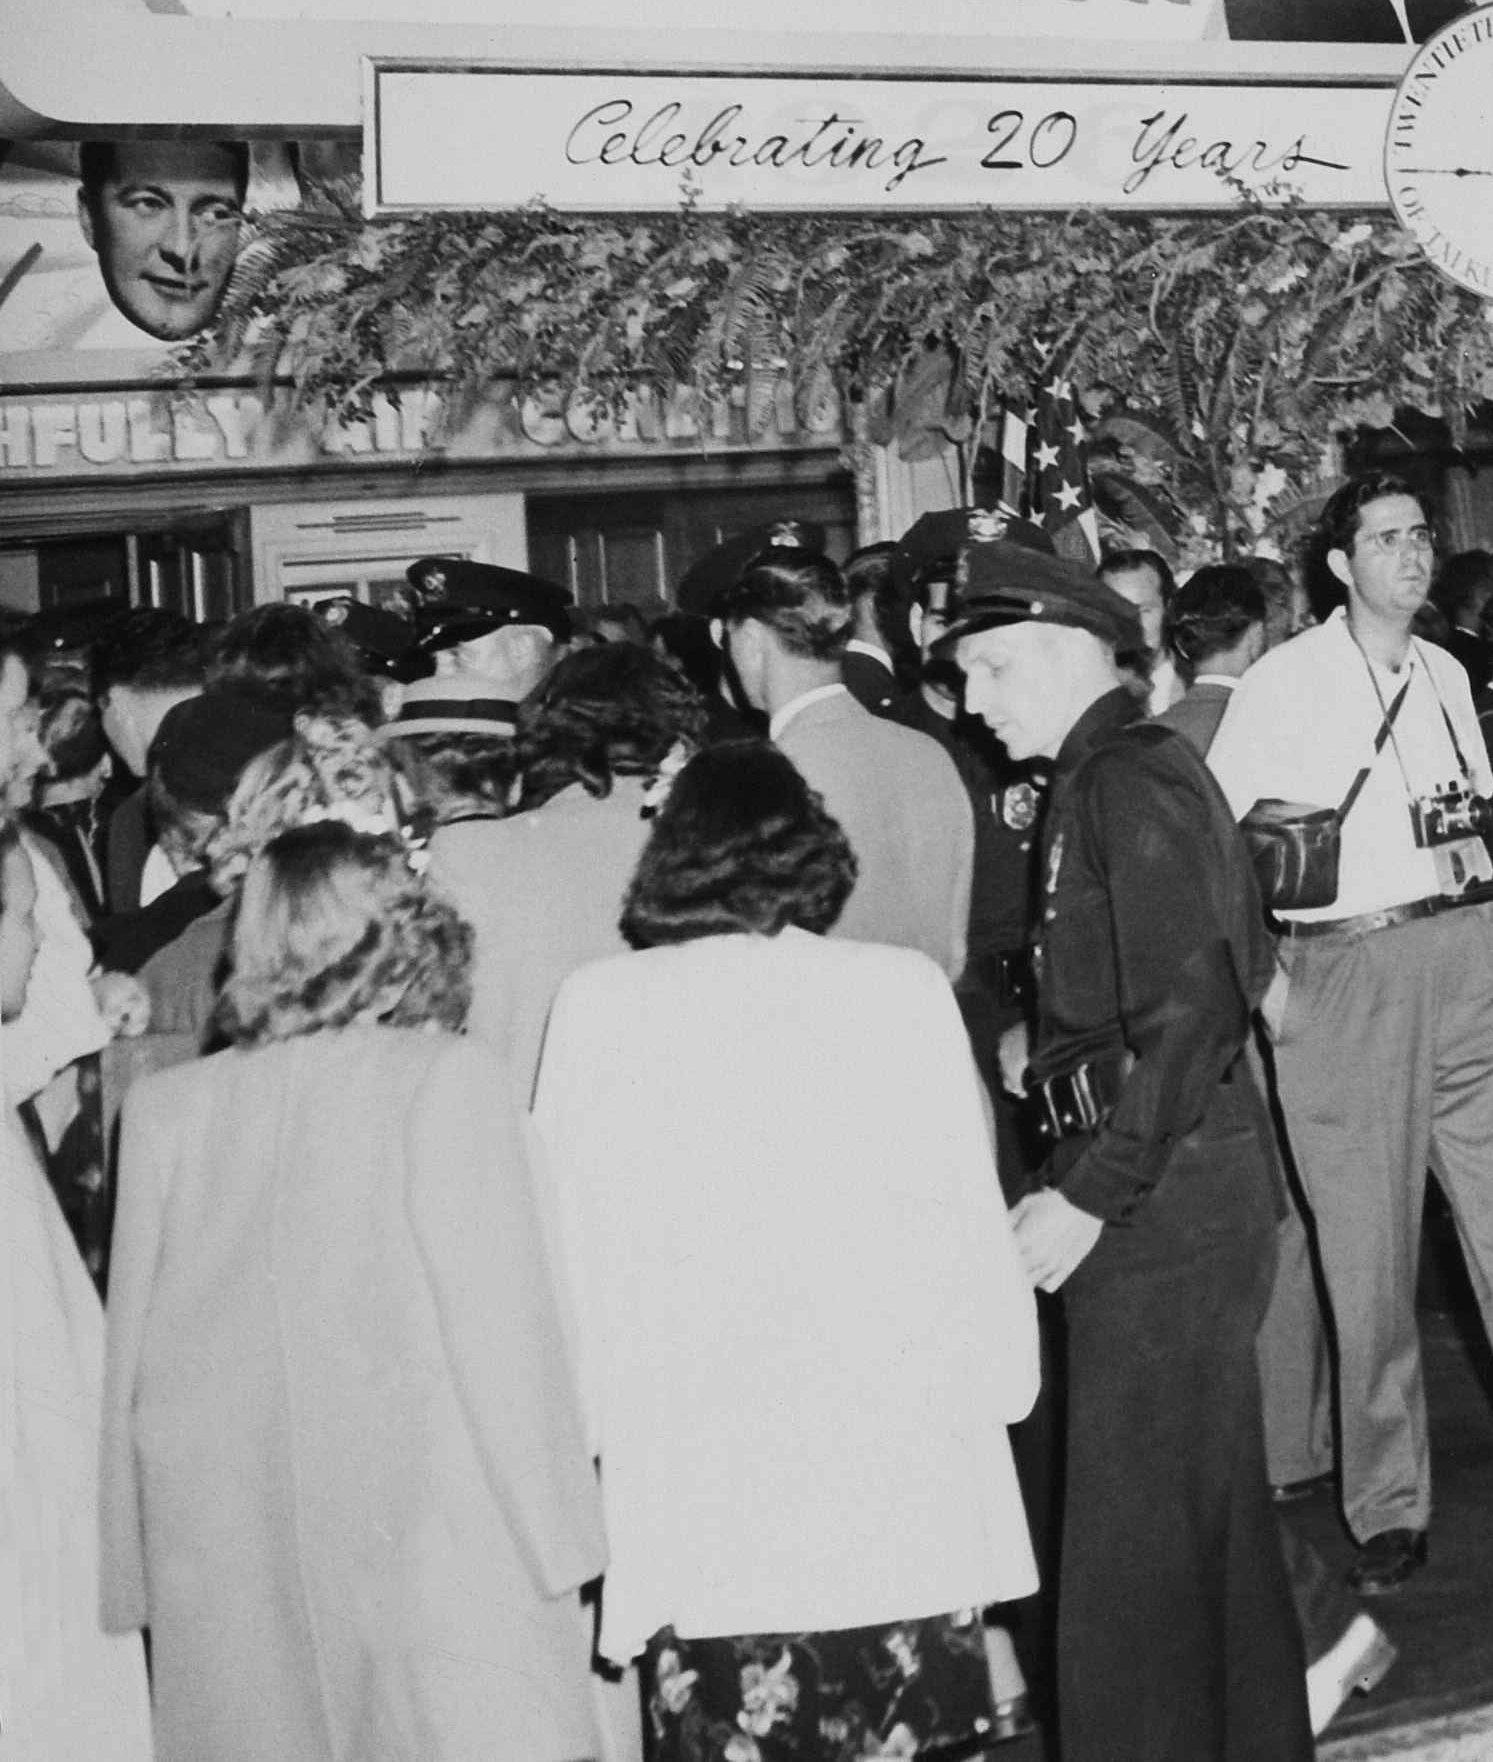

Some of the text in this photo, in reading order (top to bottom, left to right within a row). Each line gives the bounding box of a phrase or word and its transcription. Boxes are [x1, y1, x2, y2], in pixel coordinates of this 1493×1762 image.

[565, 99, 1351, 193] Celebrating 20 Years
